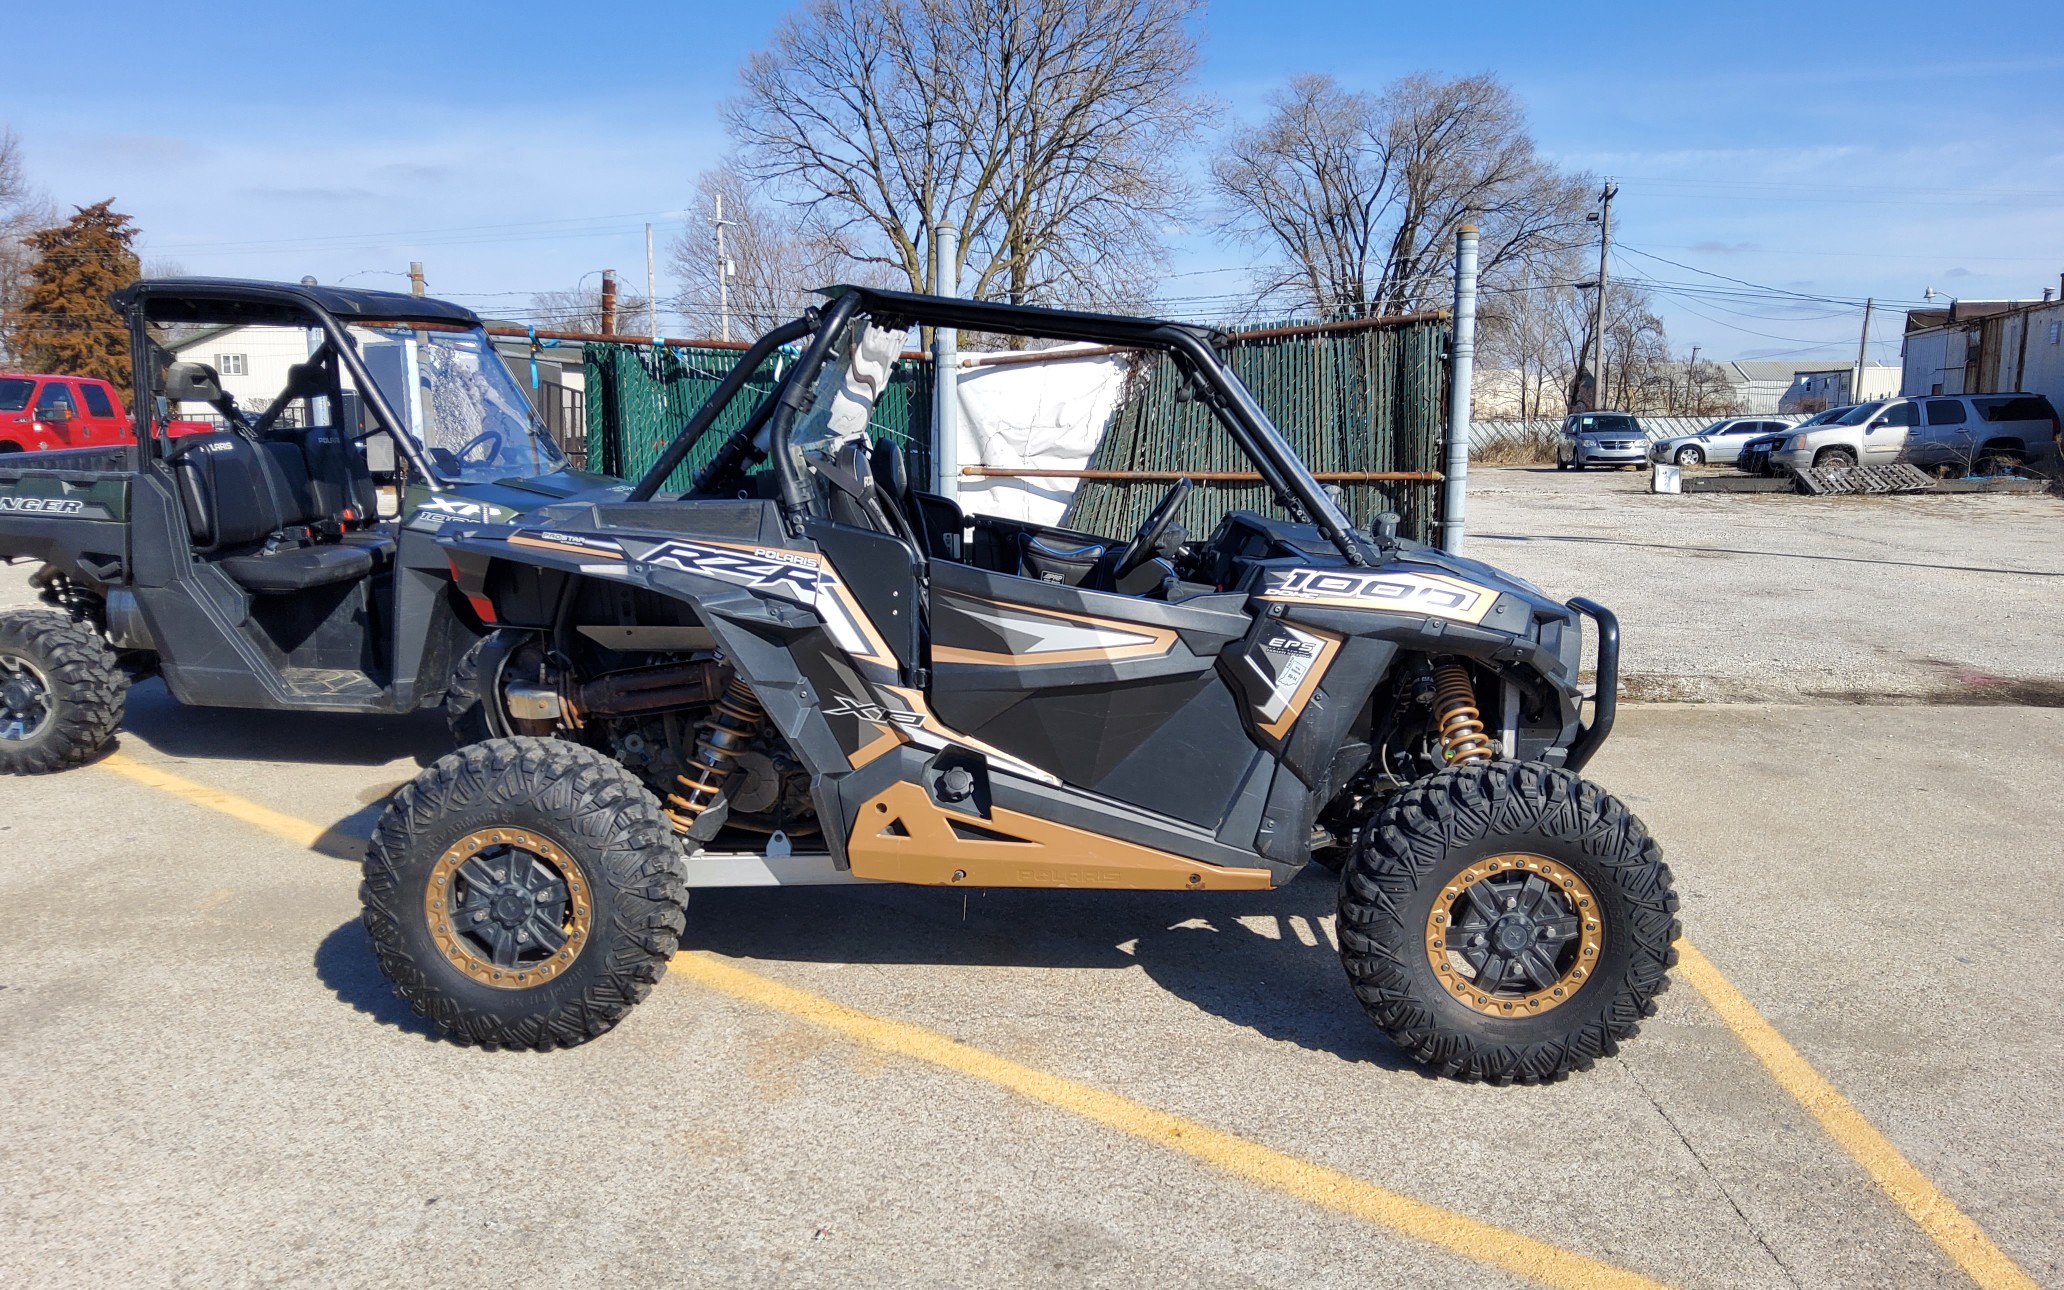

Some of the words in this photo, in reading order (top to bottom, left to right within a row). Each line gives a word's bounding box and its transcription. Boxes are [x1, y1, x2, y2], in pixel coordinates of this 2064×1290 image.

[200, 441, 233, 453] LARIS
[0, 497, 84, 514] NGER
[754, 549, 818, 567] POLARIS
[637, 541, 840, 597] RZR
[1264, 588, 1321, 599] DOHC
[1281, 568, 1481, 611] 1000
[1269, 637, 1317, 652] EPS
[822, 696, 927, 728] XP
[1016, 869, 1121, 884] POLARIS
